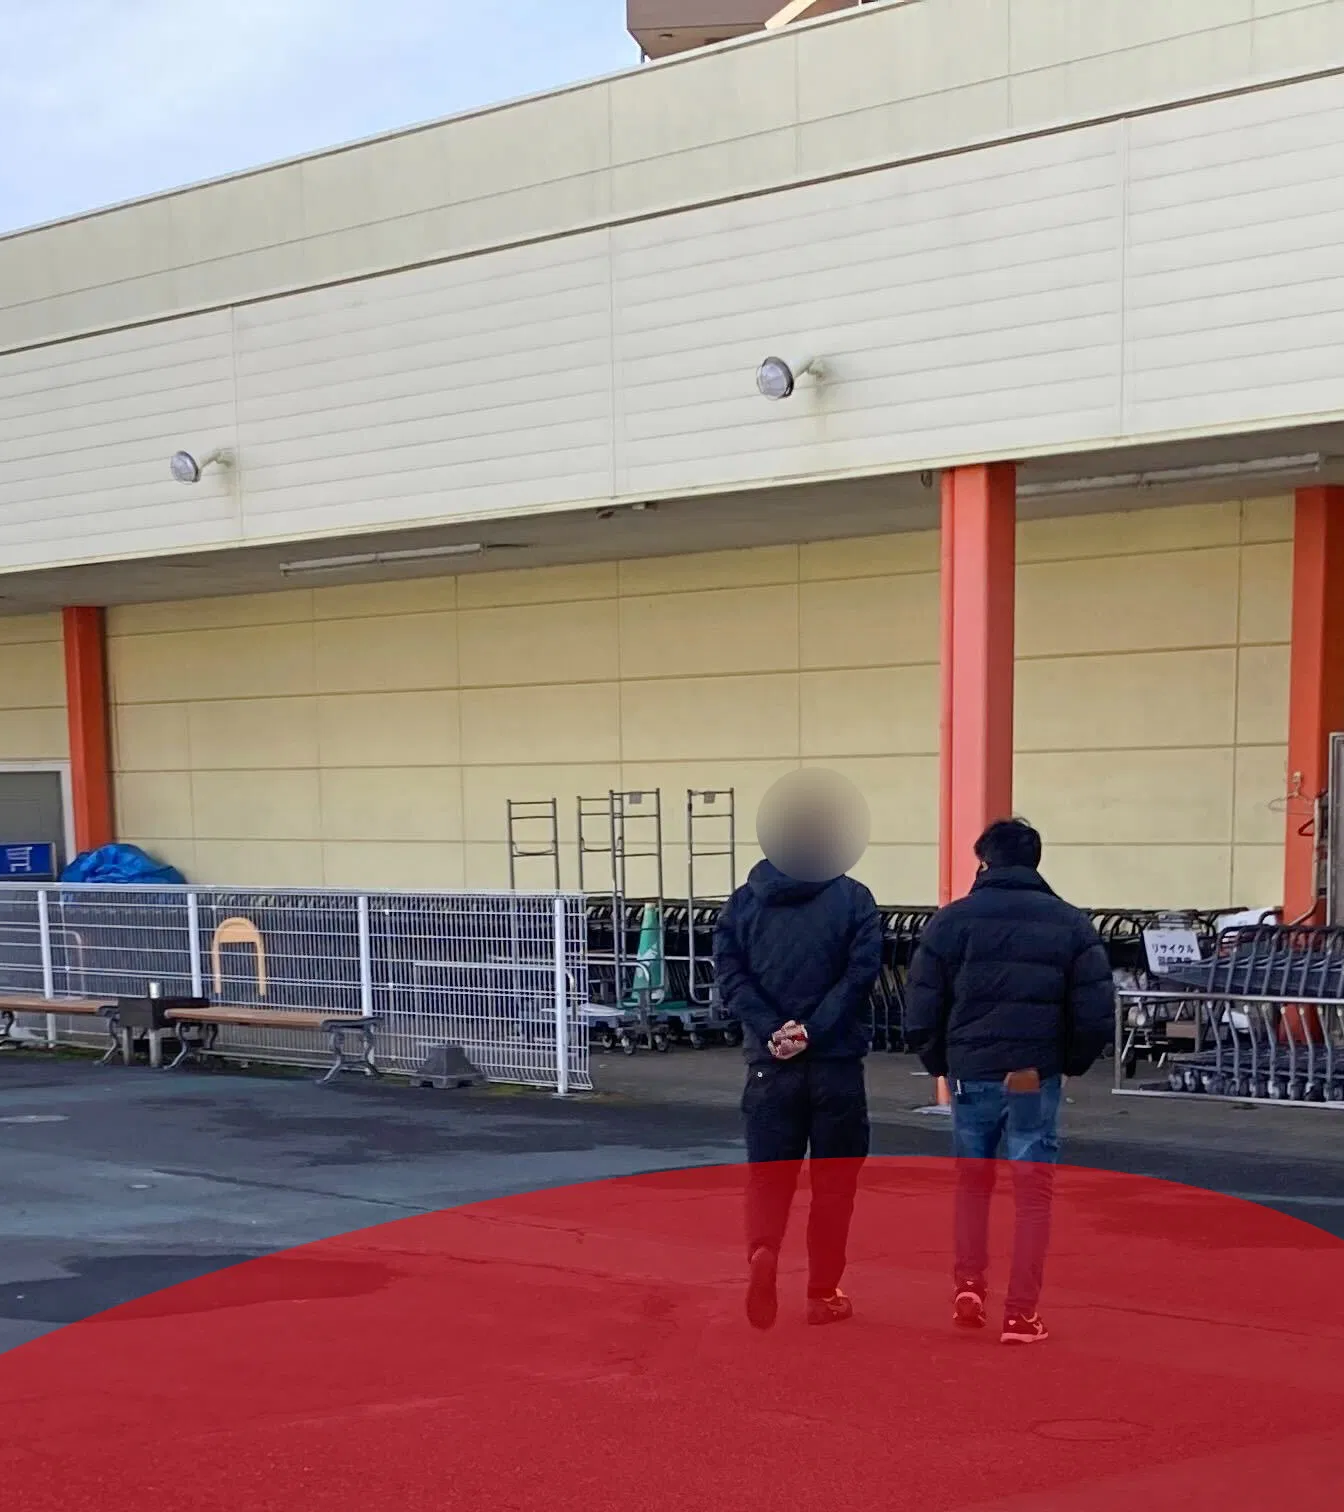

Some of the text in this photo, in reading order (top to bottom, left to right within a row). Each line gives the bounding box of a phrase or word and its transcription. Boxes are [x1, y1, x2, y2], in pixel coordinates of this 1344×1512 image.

[1151, 943, 1195, 954] リサイクル
